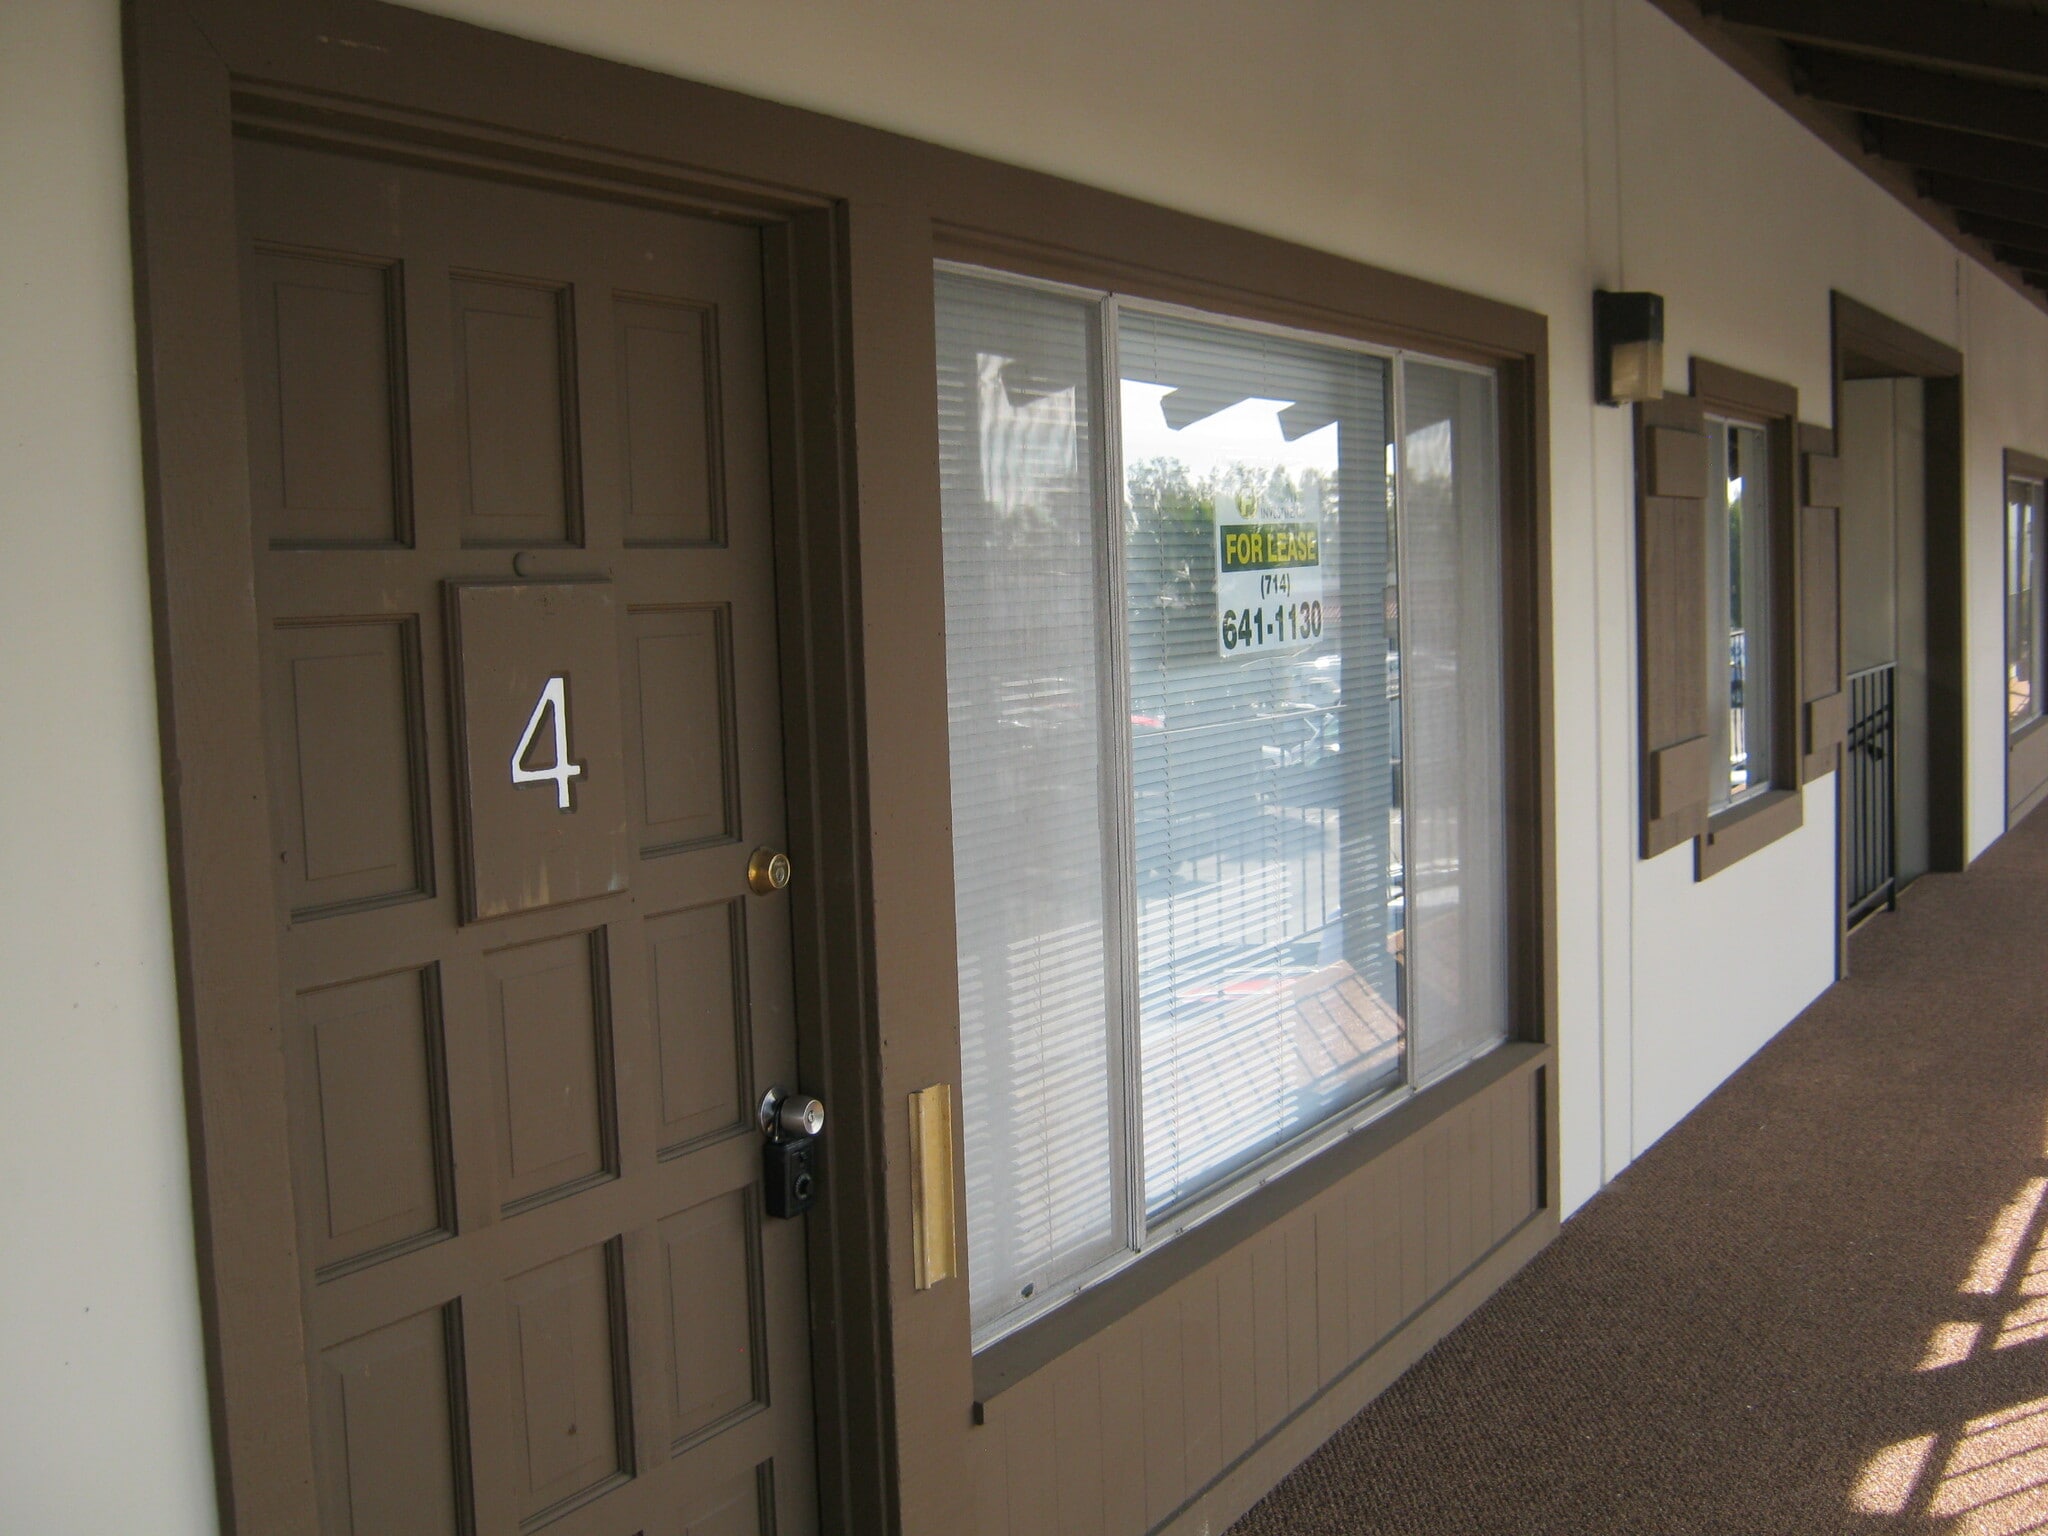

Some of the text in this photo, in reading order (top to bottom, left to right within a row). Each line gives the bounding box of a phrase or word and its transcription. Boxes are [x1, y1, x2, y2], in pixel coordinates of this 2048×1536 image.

[1226, 531, 1317, 565] FOR LEASE
[1261, 573, 1290, 599] (714)
[1222, 600, 1322, 650] 641-1130
[510, 677, 581, 808] 4
